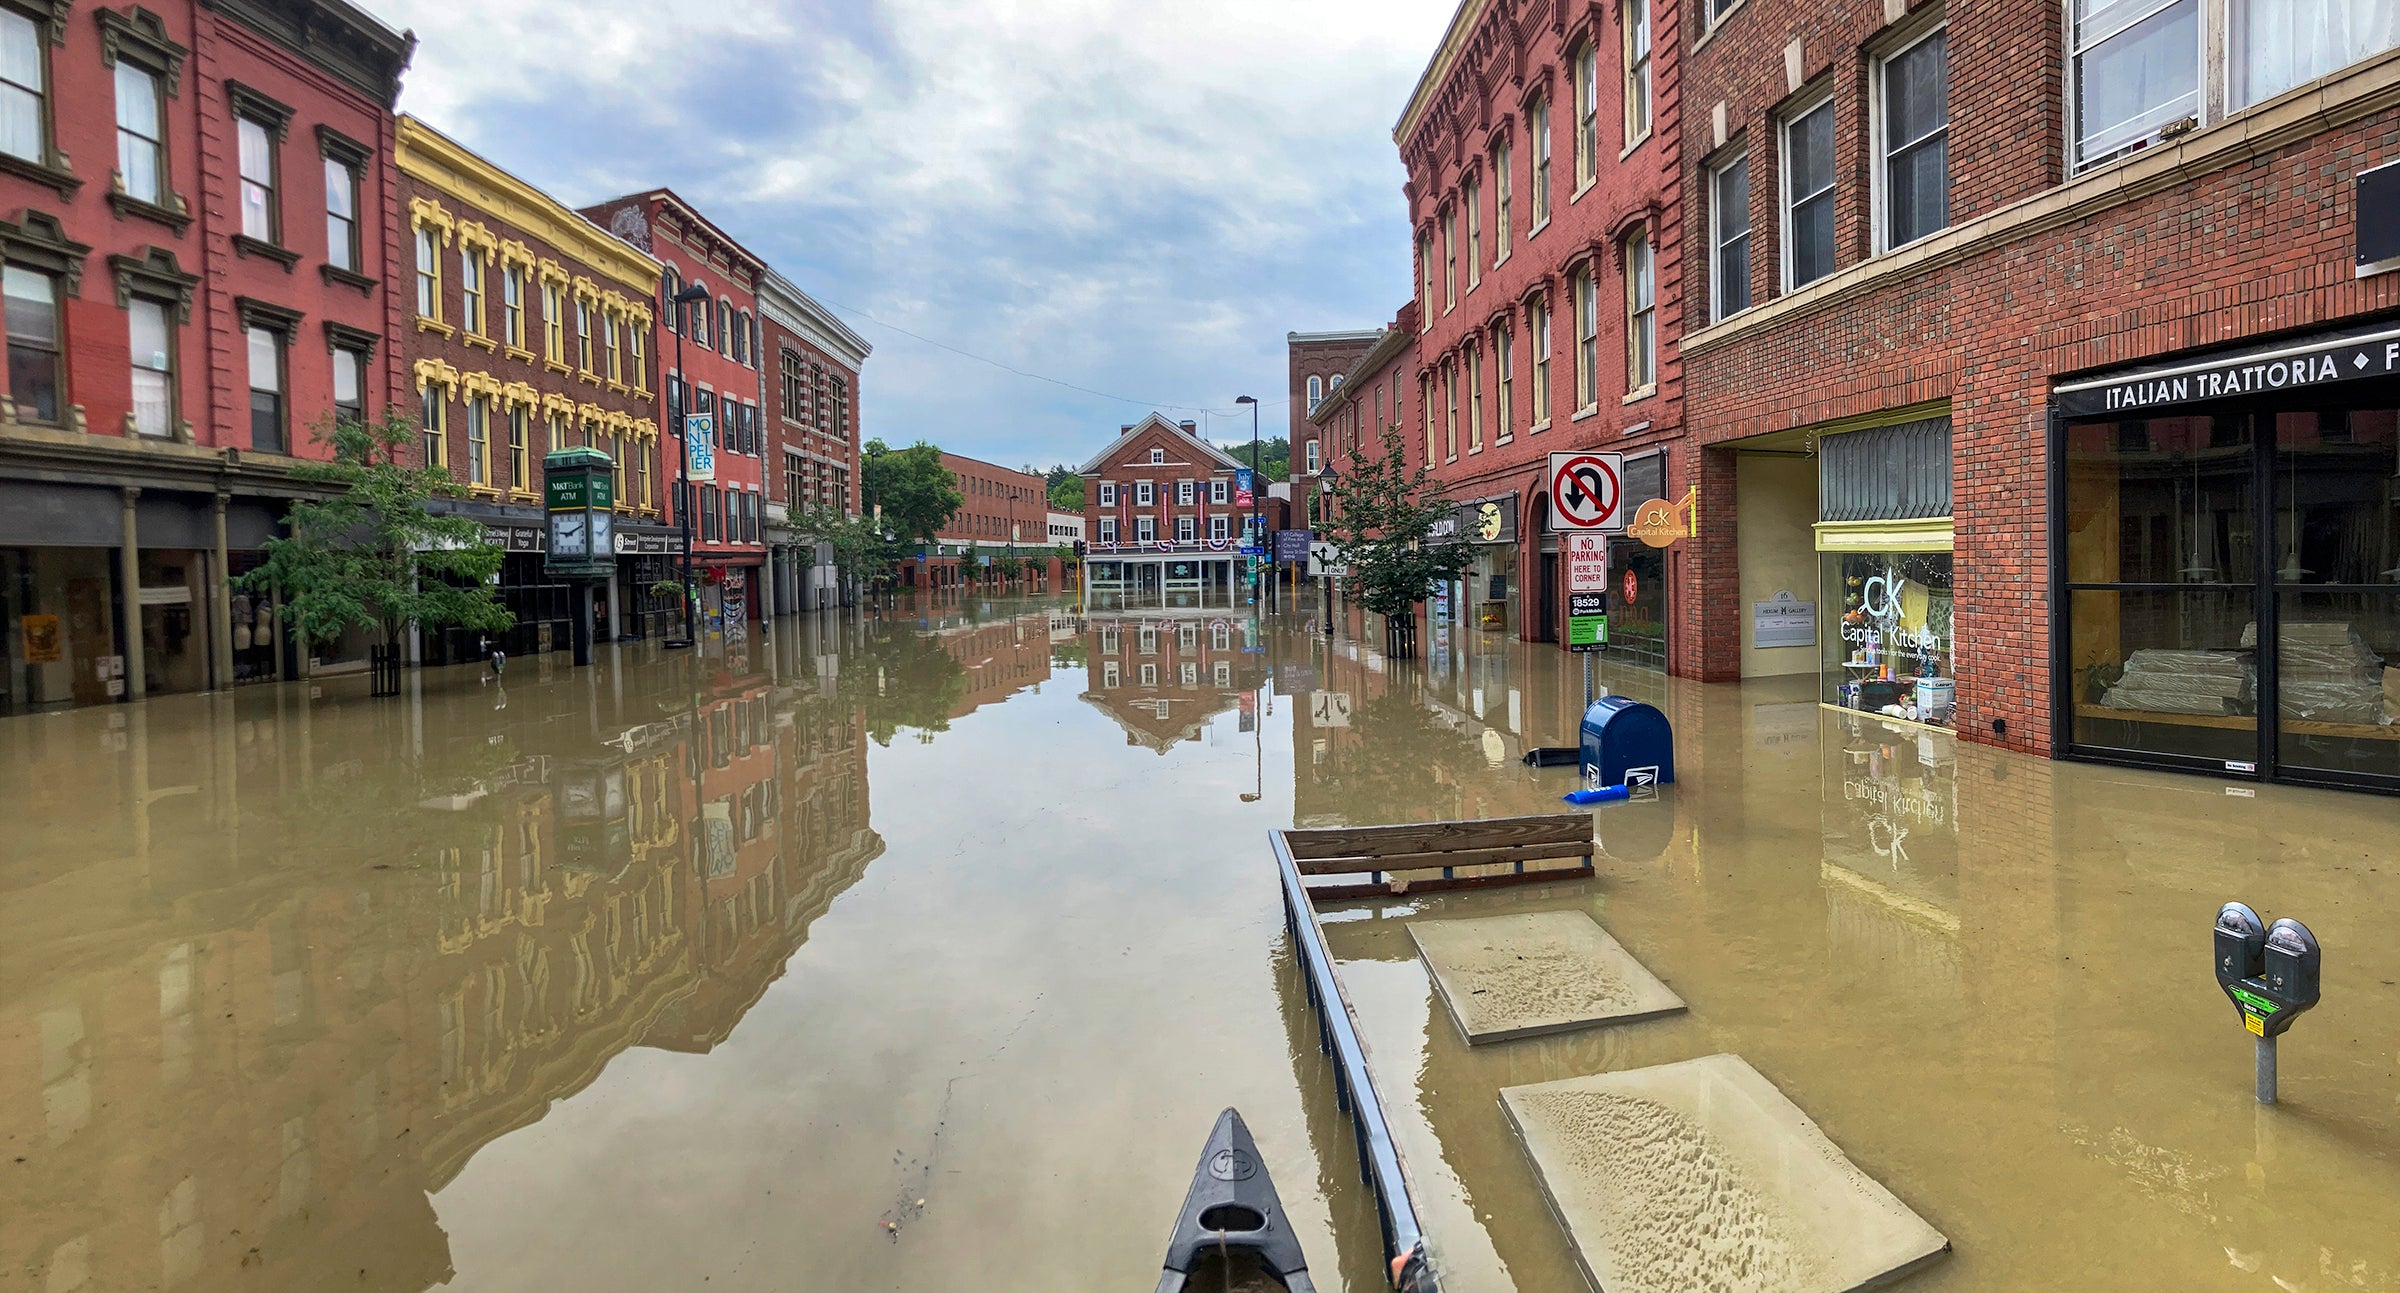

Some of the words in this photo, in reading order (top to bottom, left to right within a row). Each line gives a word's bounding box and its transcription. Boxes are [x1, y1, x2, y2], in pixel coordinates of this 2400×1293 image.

[2106, 377, 2188, 410] ITALIAN
[2197, 354, 2338, 397] TRATTORIA
[560, 492, 576, 500] ATM
[1631, 527, 1658, 537] Capital
[1659, 528, 1687, 536] Kitchen
[518, 540, 529, 548] Yoga
[1581, 539, 1594, 550] NO
[1571, 551, 1604, 562] PARKING
[1575, 574, 1601, 582] CORNER
[1572, 598, 1600, 607] 18529
[1840, 621, 1883, 647] Capital
[1890, 625, 1941, 650] Kitchen
